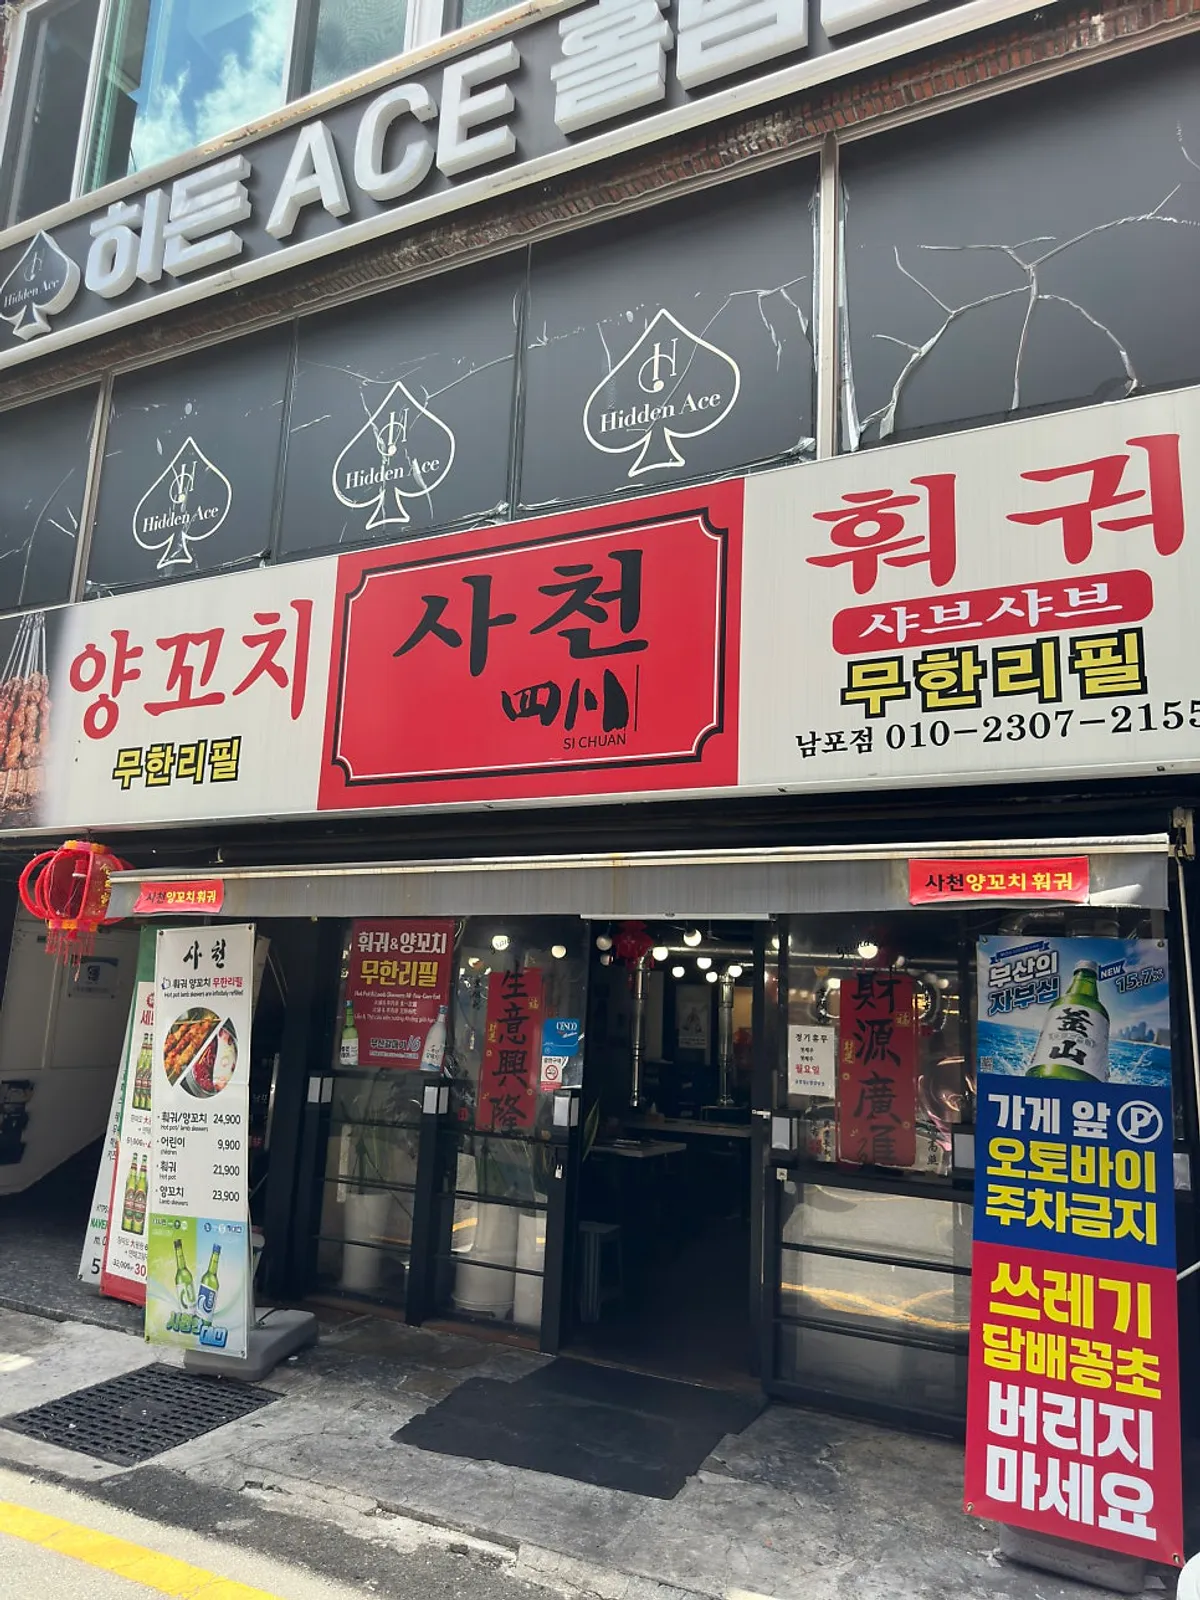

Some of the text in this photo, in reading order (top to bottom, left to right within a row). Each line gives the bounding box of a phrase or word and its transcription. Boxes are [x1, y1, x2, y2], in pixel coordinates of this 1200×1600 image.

[85, 155, 252, 300] 히든
[265, 40, 522, 240] ACE
[3, 279, 60, 308] Hidden Ace
[600, 392, 721, 433] Hidden Ace
[345, 458, 440, 490] Hidden Ace
[142, 505, 219, 532] Hidden Ace
[392, 549, 650, 677] 사천
[858, 583, 1124, 643] 샤브샤브
[69, 598, 314, 740] 양꼬치
[840, 626, 1149, 720] 무한리필
[563, 733, 627, 750] SI CHUAN
[795, 727, 874, 759] 남포점
[112, 735, 243, 790] 무한리필
[1031, 872, 1073, 891] 훠궈
[183, 938, 227, 970] 사천
[357, 931, 447, 954] 훠궈&양꼬치
[189, 977, 211, 989] 양꼬치
[213, 976, 244, 989] 무한리필
[360, 960, 439, 987] 무한리필
[988, 951, 1059, 988] 부산의
[1100, 964, 1123, 979] NEW
[988, 976, 1061, 1017] 자부심
[795, 1063, 820, 1075] 월요일
[162, 1111, 208, 1125] 훠궈/양꼬치
[213, 1113, 241, 1126] 24,900
[988, 1094, 1060, 1135] 가게
[1072, 1100, 1111, 1139] 앞
[160, 1137, 186, 1148] 어린이
[217, 1139, 241, 1151] 9,900
[160, 1161, 240, 1177] 훠궈 21,900
[986, 1137, 1157, 1194] 오토바이
[160, 1185, 240, 1202] 양꼬치 23,900
[985, 1184, 1158, 1247] 주차금지
[988, 1262, 1152, 1340] 쓰레기
[982, 1322, 1162, 1400] 담배꽁초
[987, 1380, 1154, 1470] 버리지
[985, 1444, 1157, 1541] 마세요
